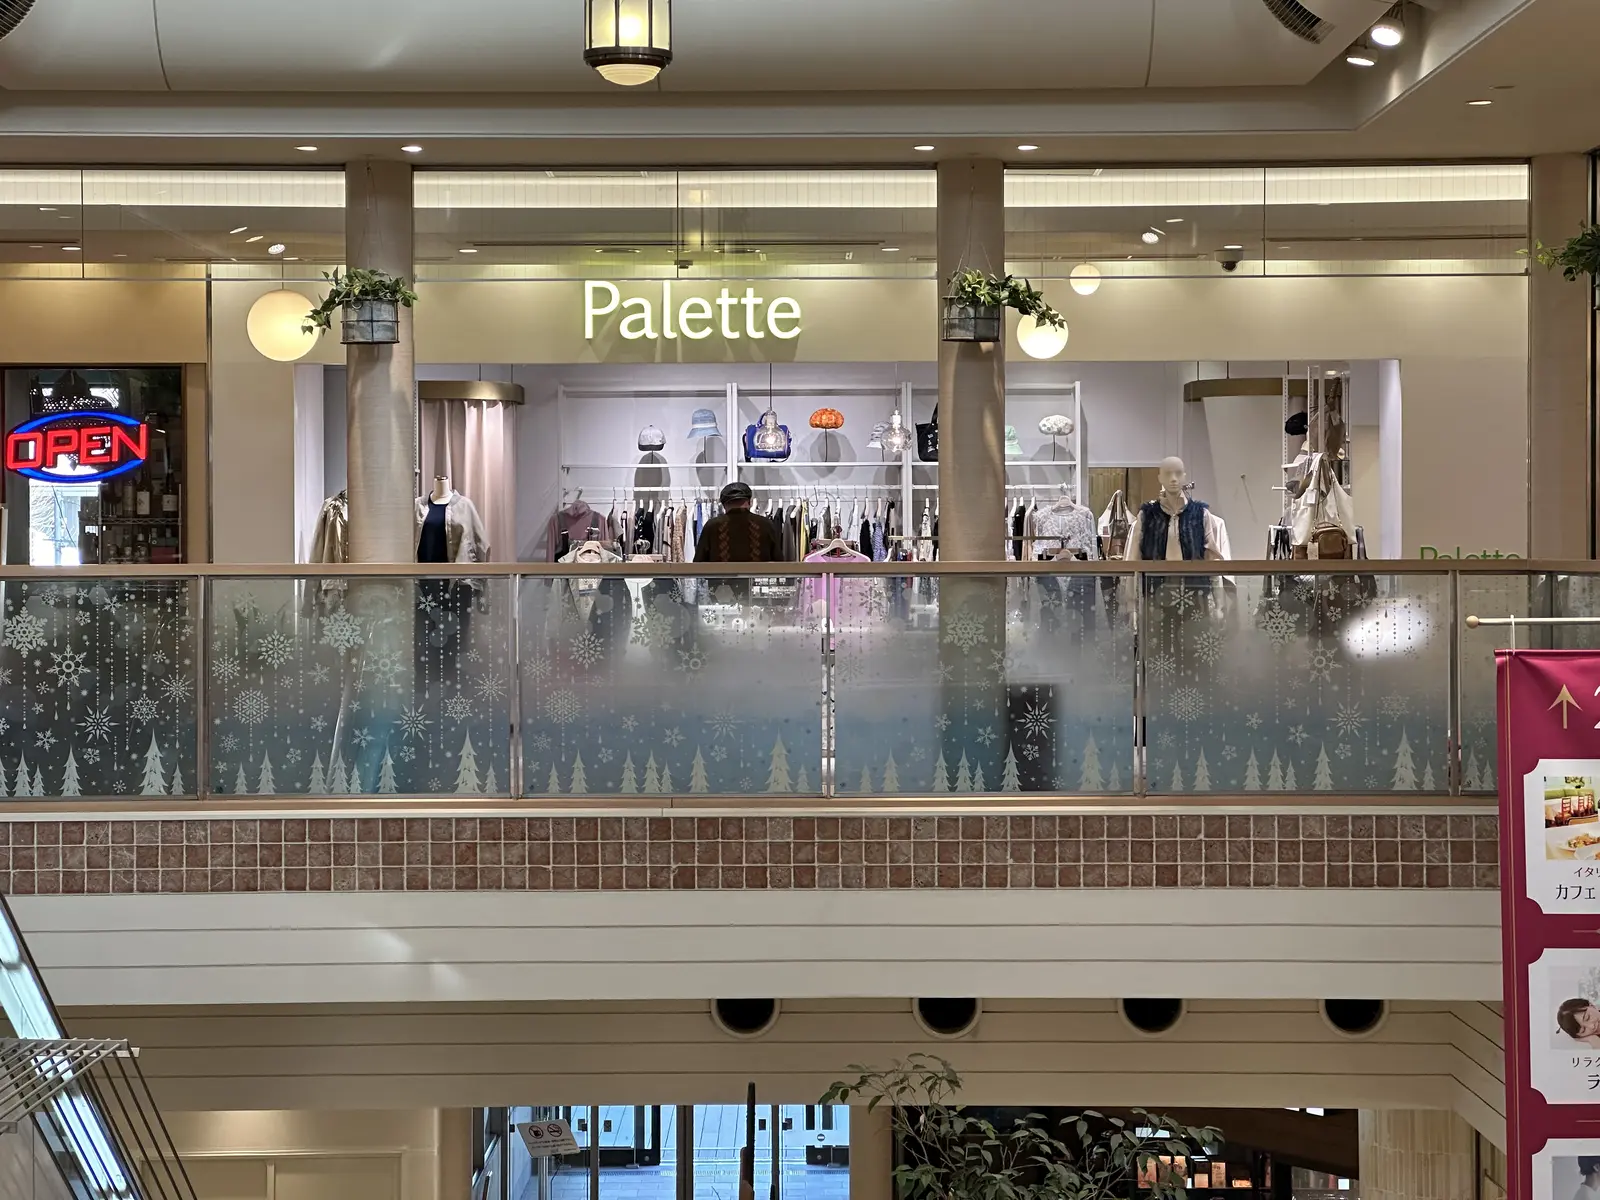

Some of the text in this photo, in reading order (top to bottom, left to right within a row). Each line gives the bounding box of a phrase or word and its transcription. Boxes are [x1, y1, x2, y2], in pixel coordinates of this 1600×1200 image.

[584, 280, 802, 340] Palette
[6, 424, 148, 470] OPEN
[1555, 883, 1596, 900] カフェ
